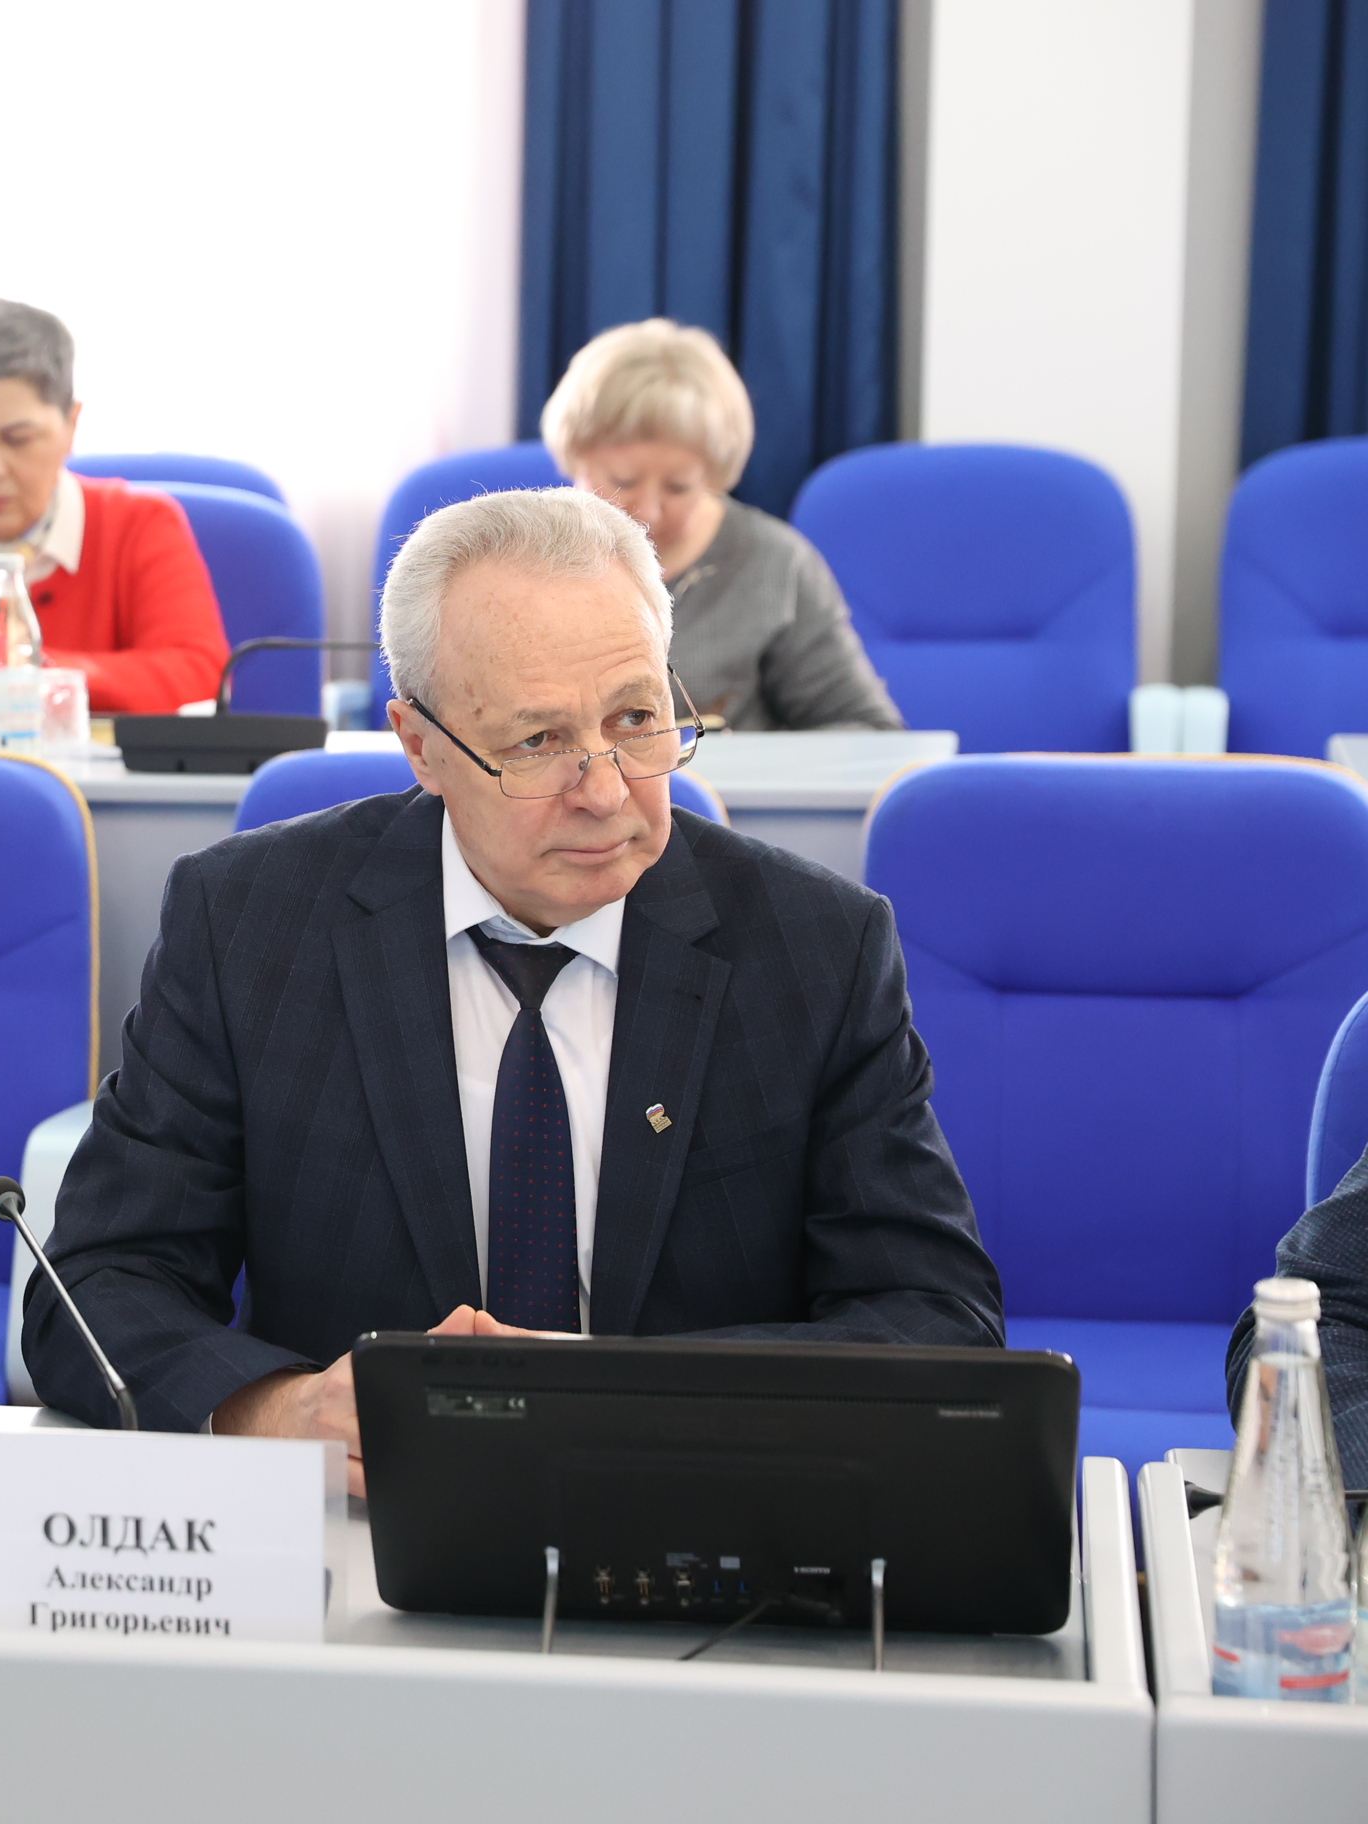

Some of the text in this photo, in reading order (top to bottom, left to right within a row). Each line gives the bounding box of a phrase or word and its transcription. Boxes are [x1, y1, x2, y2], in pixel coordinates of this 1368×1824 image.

[43, 1512, 216, 1556] ОЛДАК
[46, 1565, 214, 1601] Александр
[30, 1602, 231, 1636] Григорьевич
